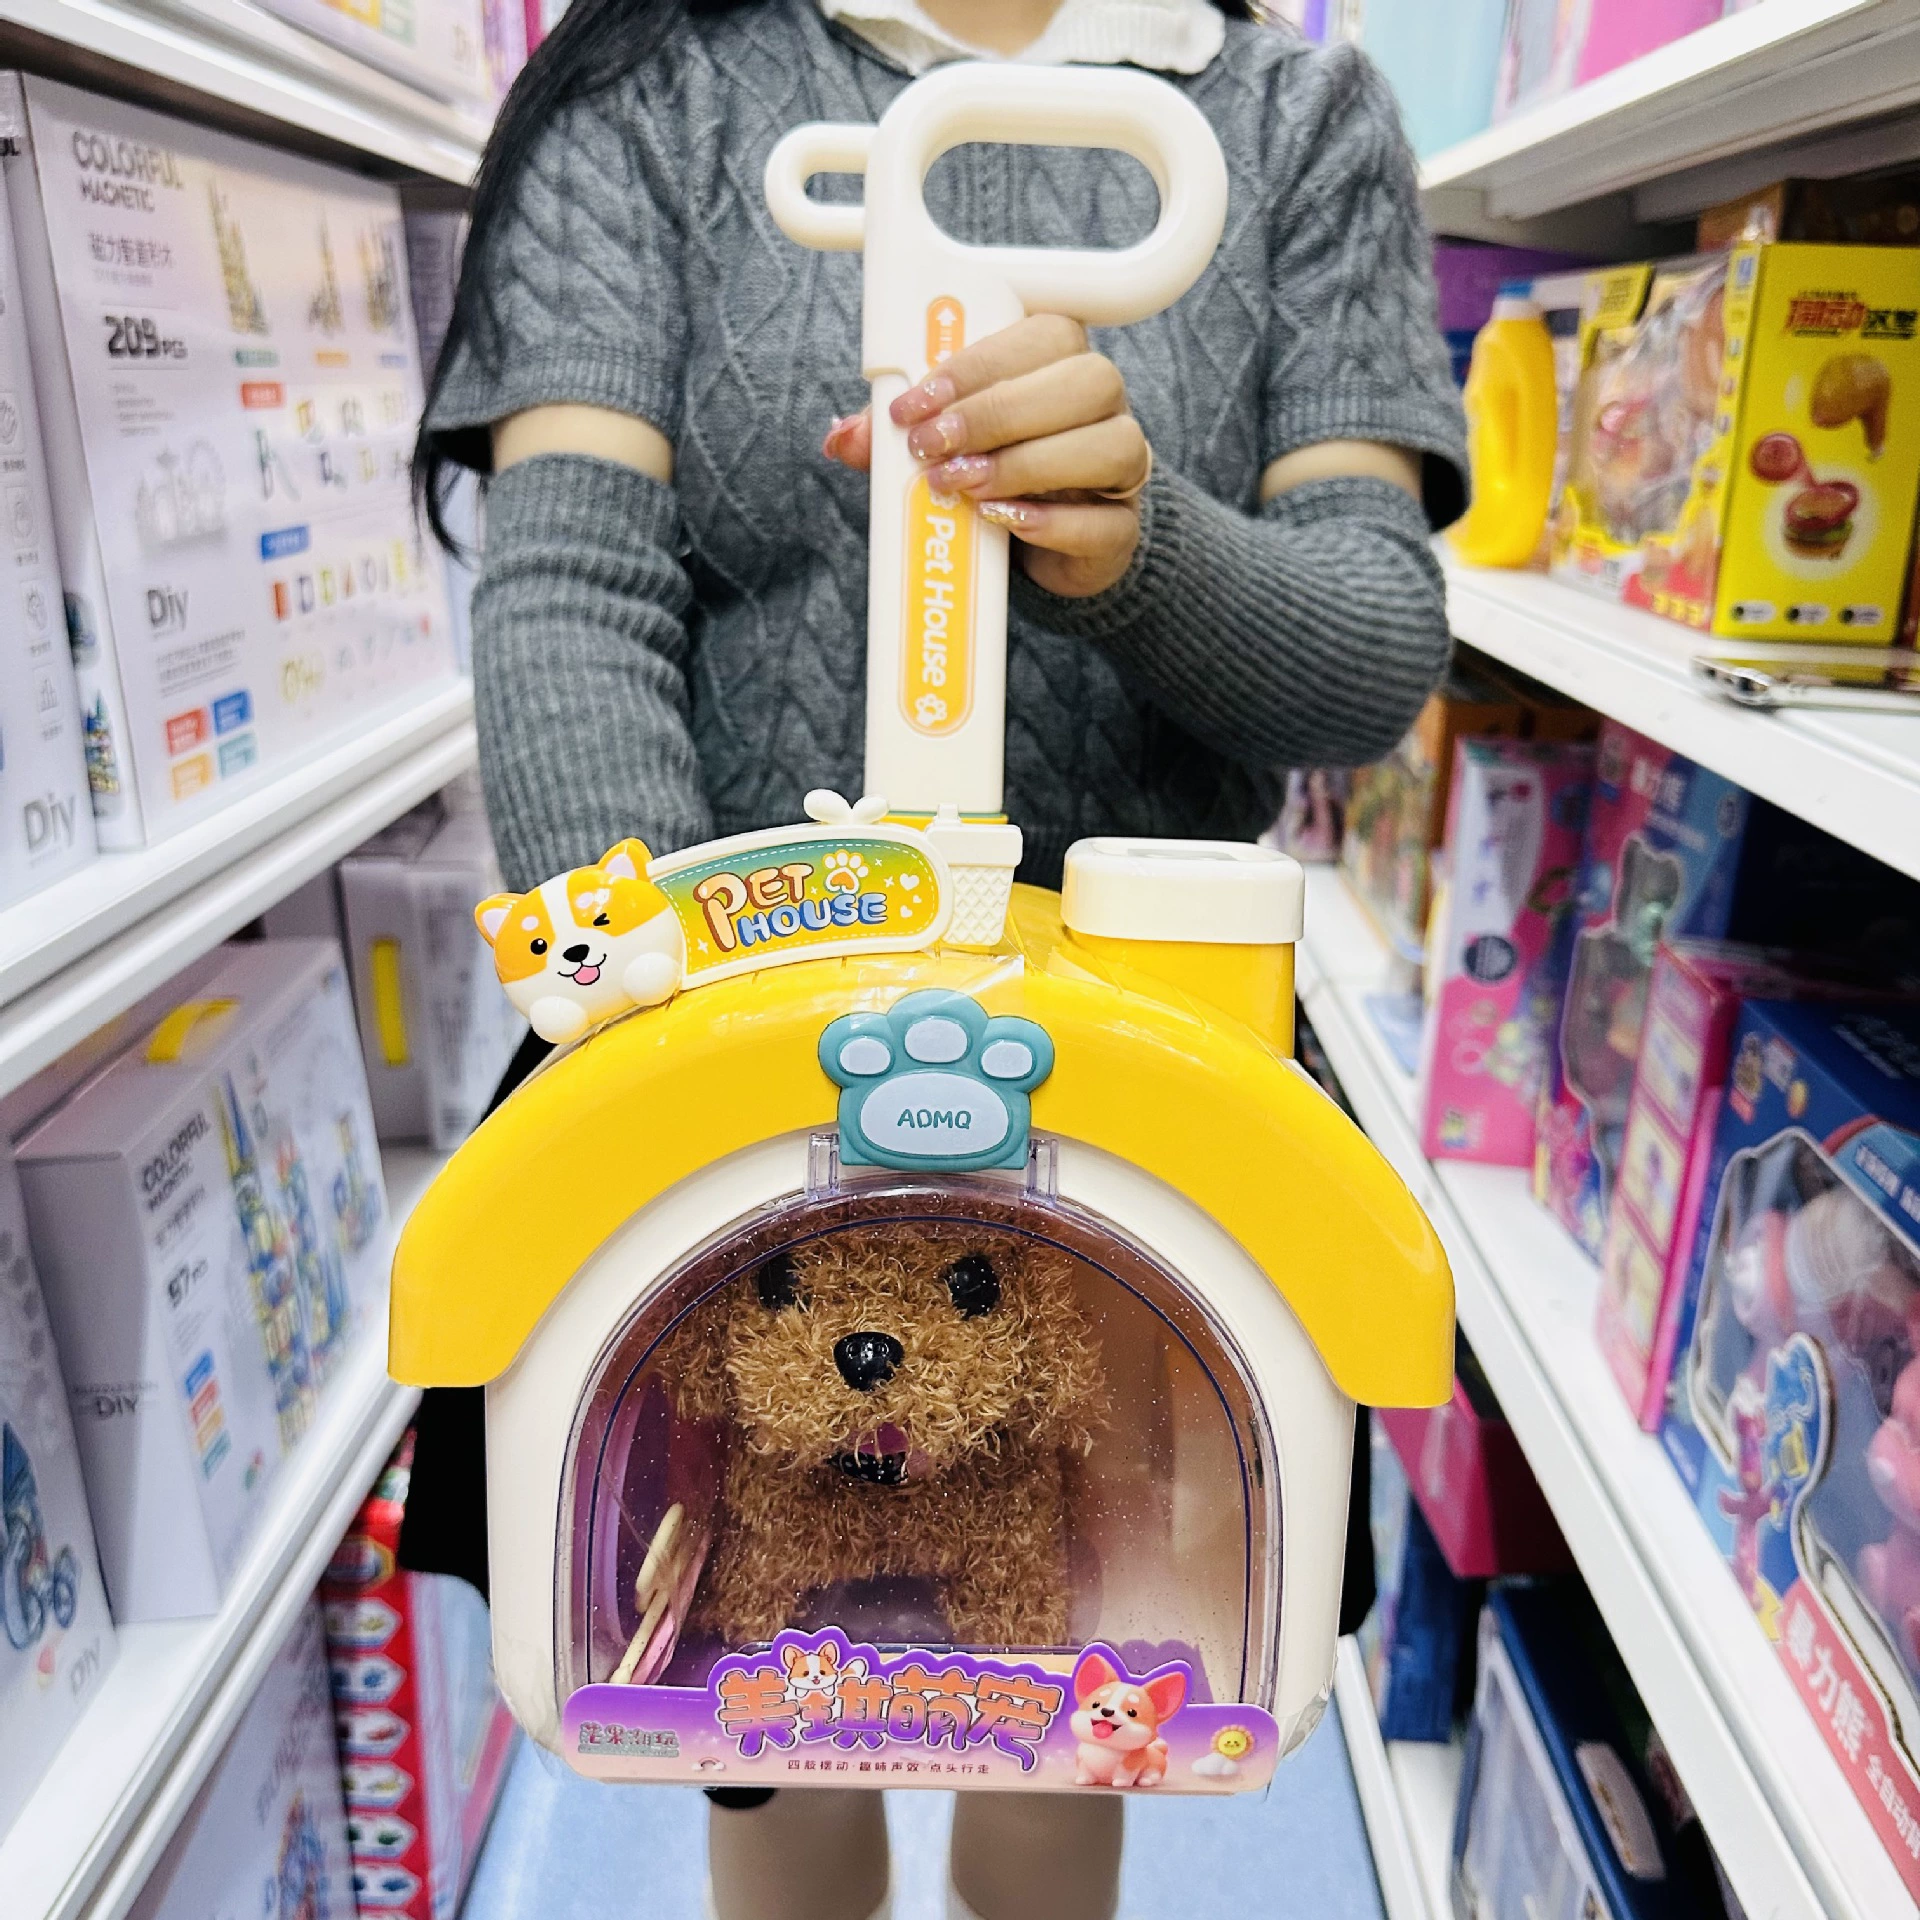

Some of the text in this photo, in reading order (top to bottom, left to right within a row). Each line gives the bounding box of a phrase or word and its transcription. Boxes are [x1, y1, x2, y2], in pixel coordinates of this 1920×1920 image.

[922, 515, 955, 687] Pet House
[693, 863, 814, 952] PET
[737, 891, 888, 947] HOUSE
[897, 1108, 972, 1131] ADMQ
[718, 1667, 1063, 1772] 美琪萌宠
